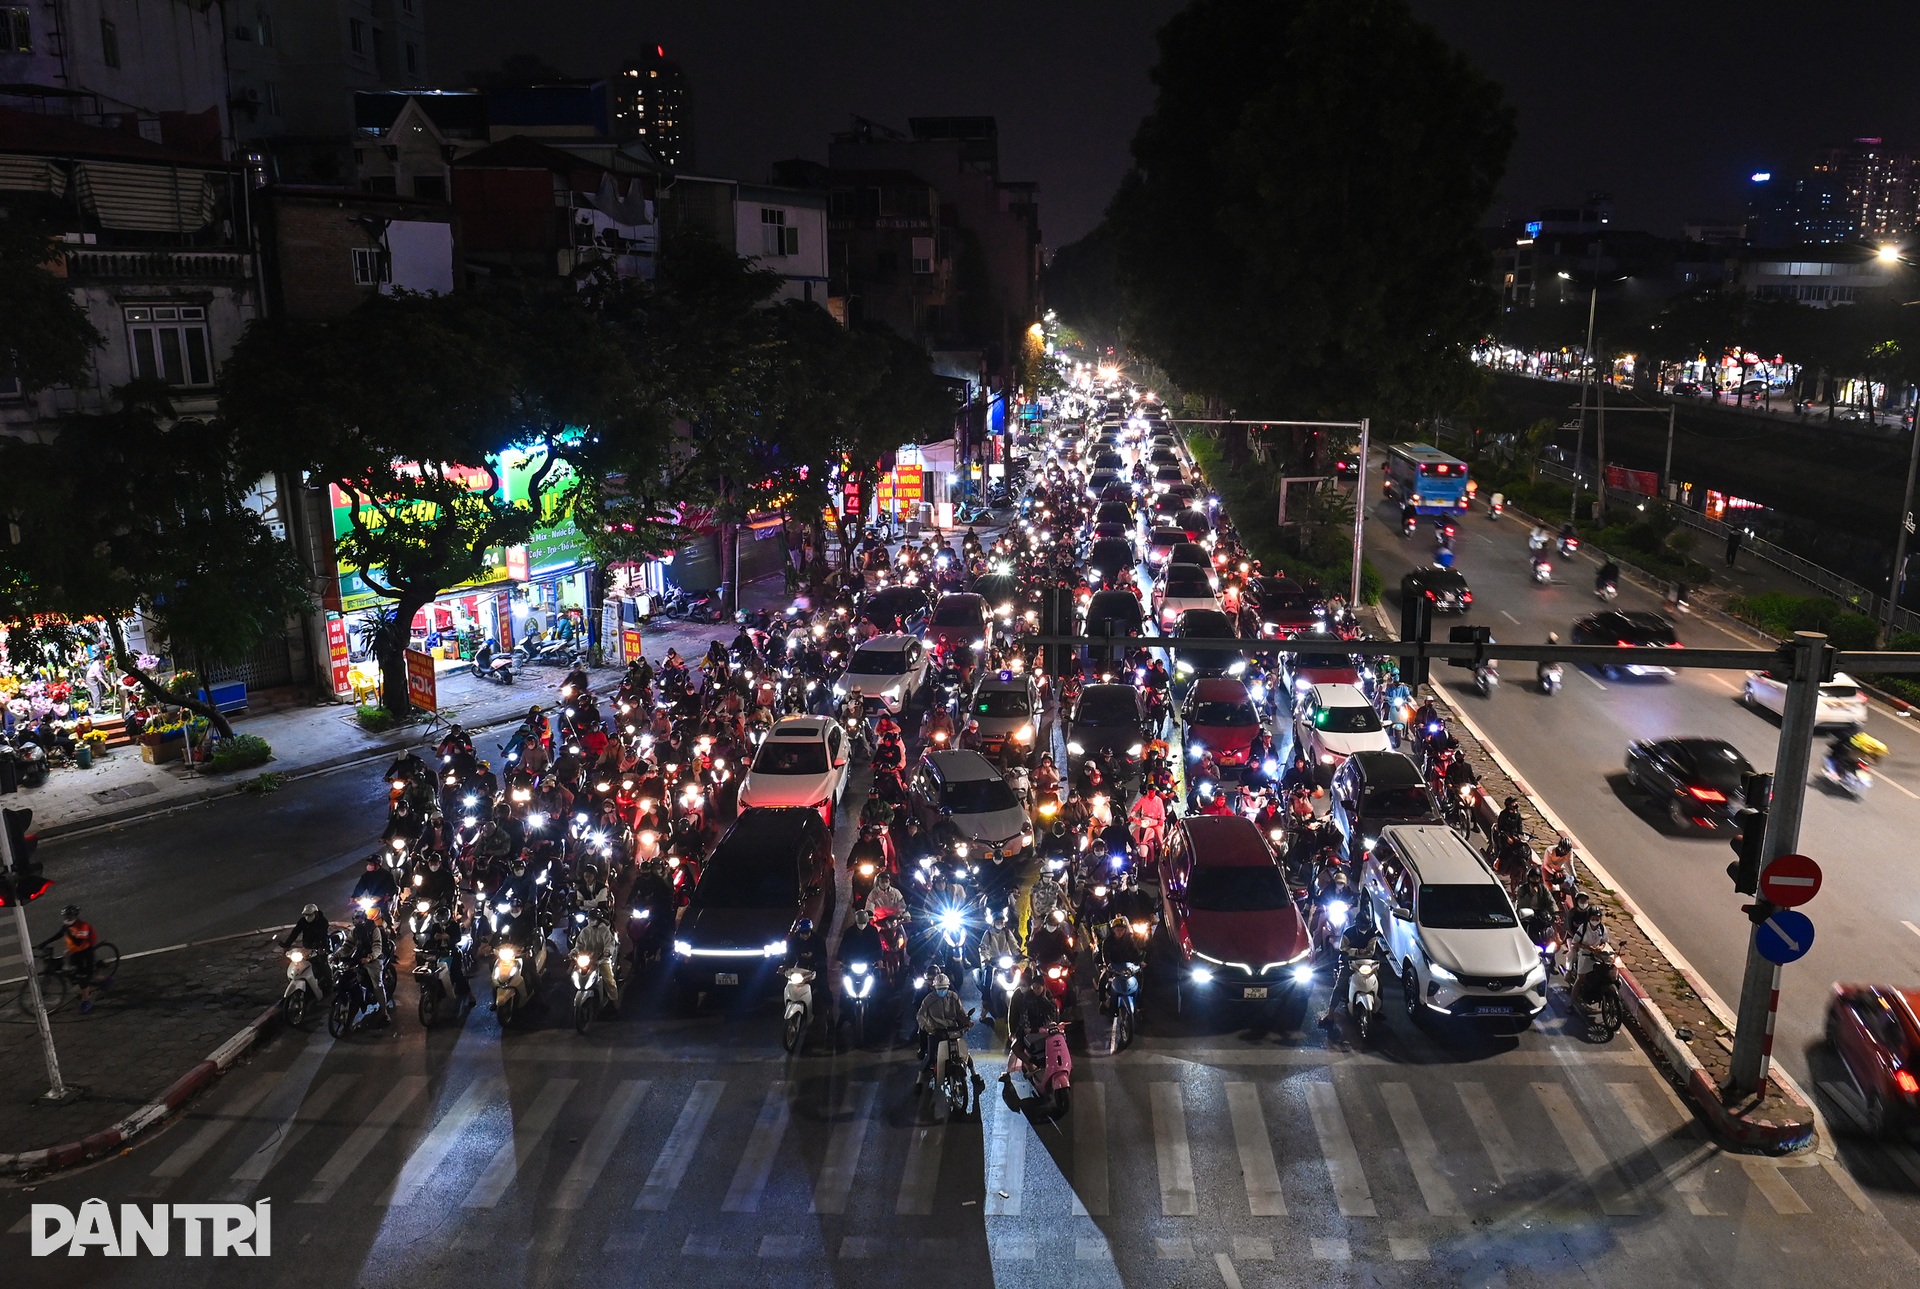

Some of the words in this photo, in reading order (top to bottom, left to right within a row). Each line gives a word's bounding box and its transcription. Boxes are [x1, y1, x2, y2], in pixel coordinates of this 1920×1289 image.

[469, 473, 489, 488] MÁY
[625, 641, 632, 652] XE
[632, 642, 640, 653] GA
